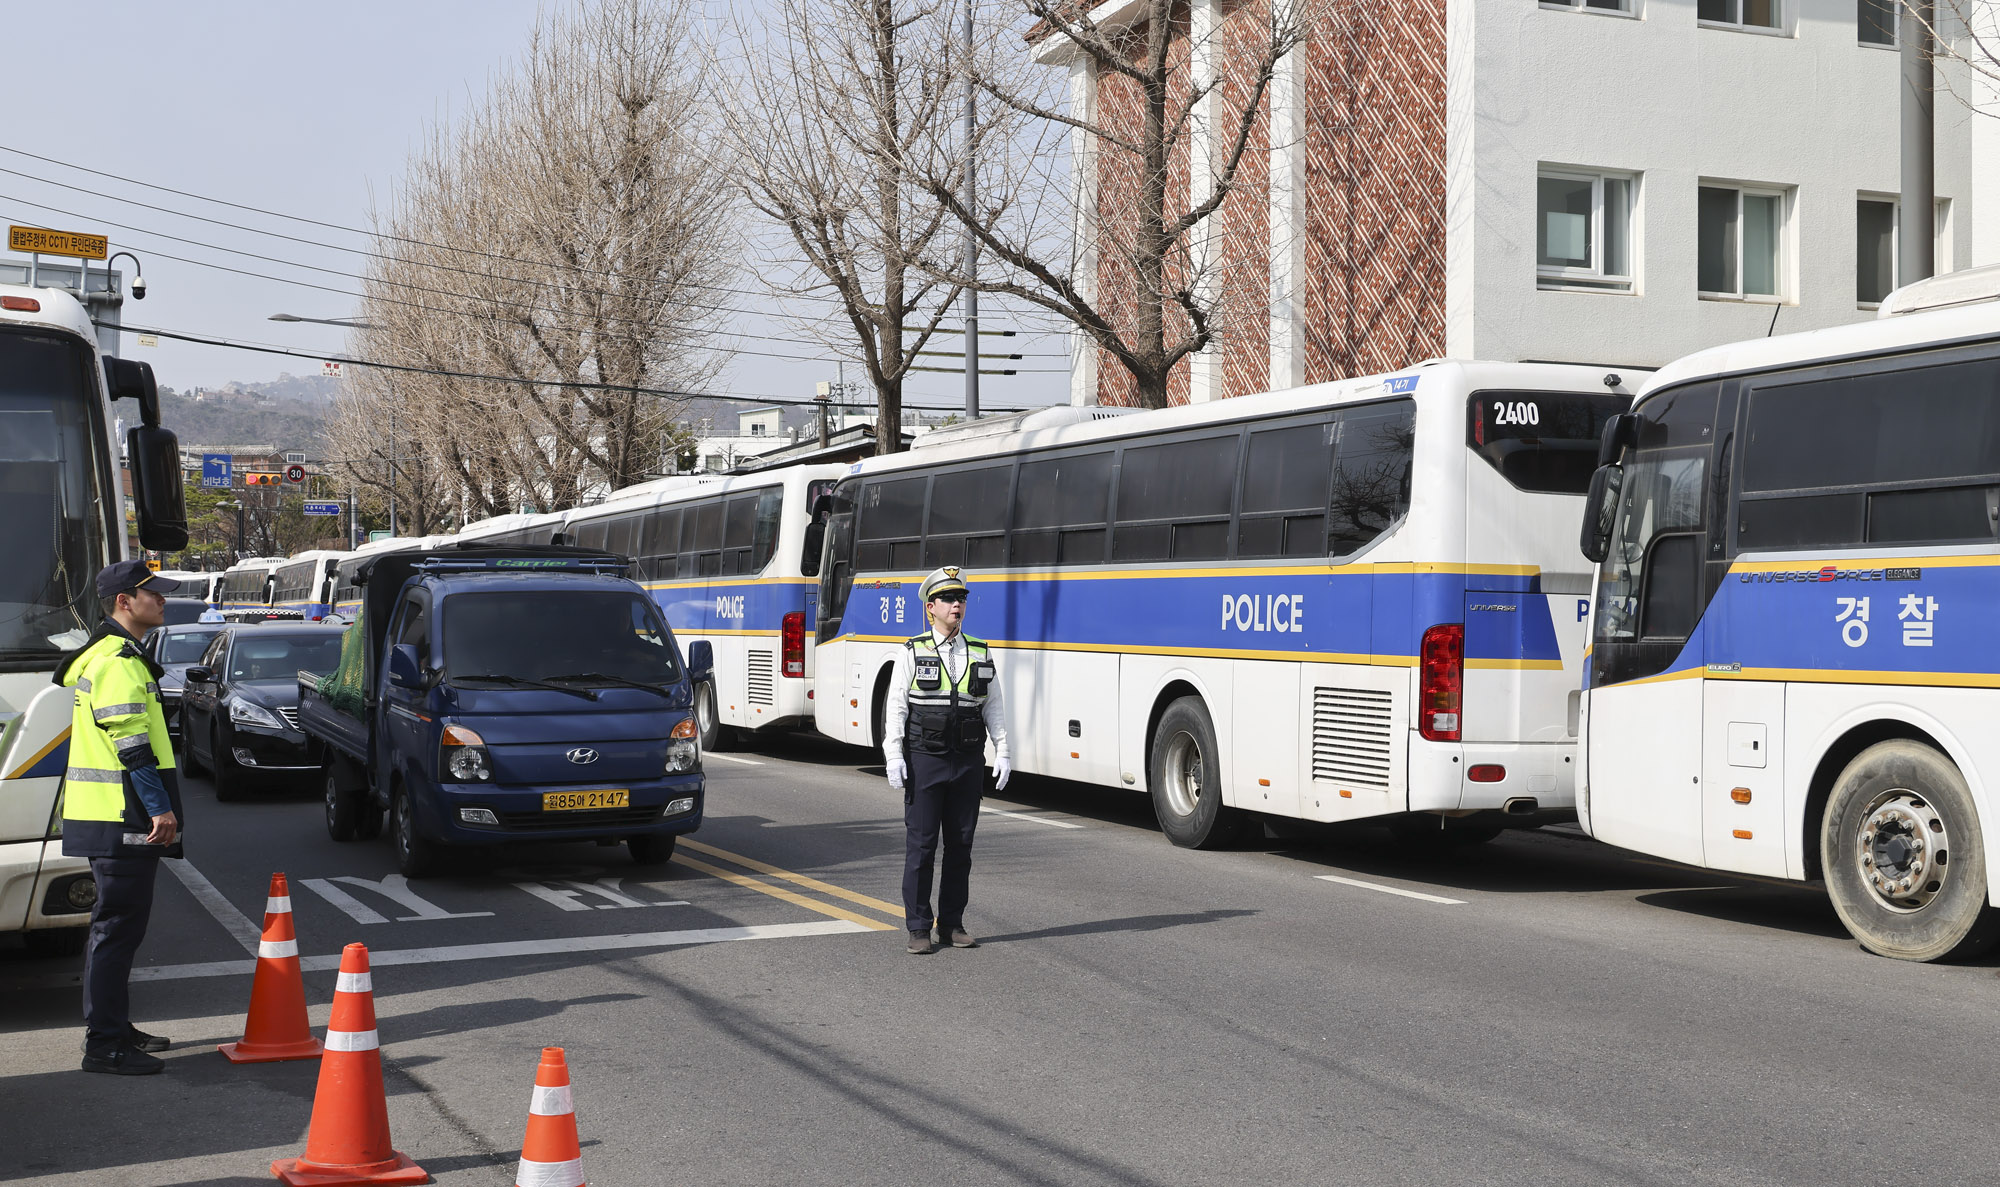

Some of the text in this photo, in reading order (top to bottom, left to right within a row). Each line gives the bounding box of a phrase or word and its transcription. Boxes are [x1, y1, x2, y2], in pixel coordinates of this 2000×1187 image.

[13, 230, 105, 255] 불법주정차 CCTV 무인단속중
[1493, 401, 1540, 426] 2400
[290, 469, 302, 479] 30
[203, 476, 231, 488] 비보호
[495, 559, 569, 567] Carrier
[716, 595, 745, 619] POLICE
[1221, 593, 1304, 633] POLICE
[1469, 604, 1517, 612] UNIVERSE
[588, 792, 624, 807] 2147
